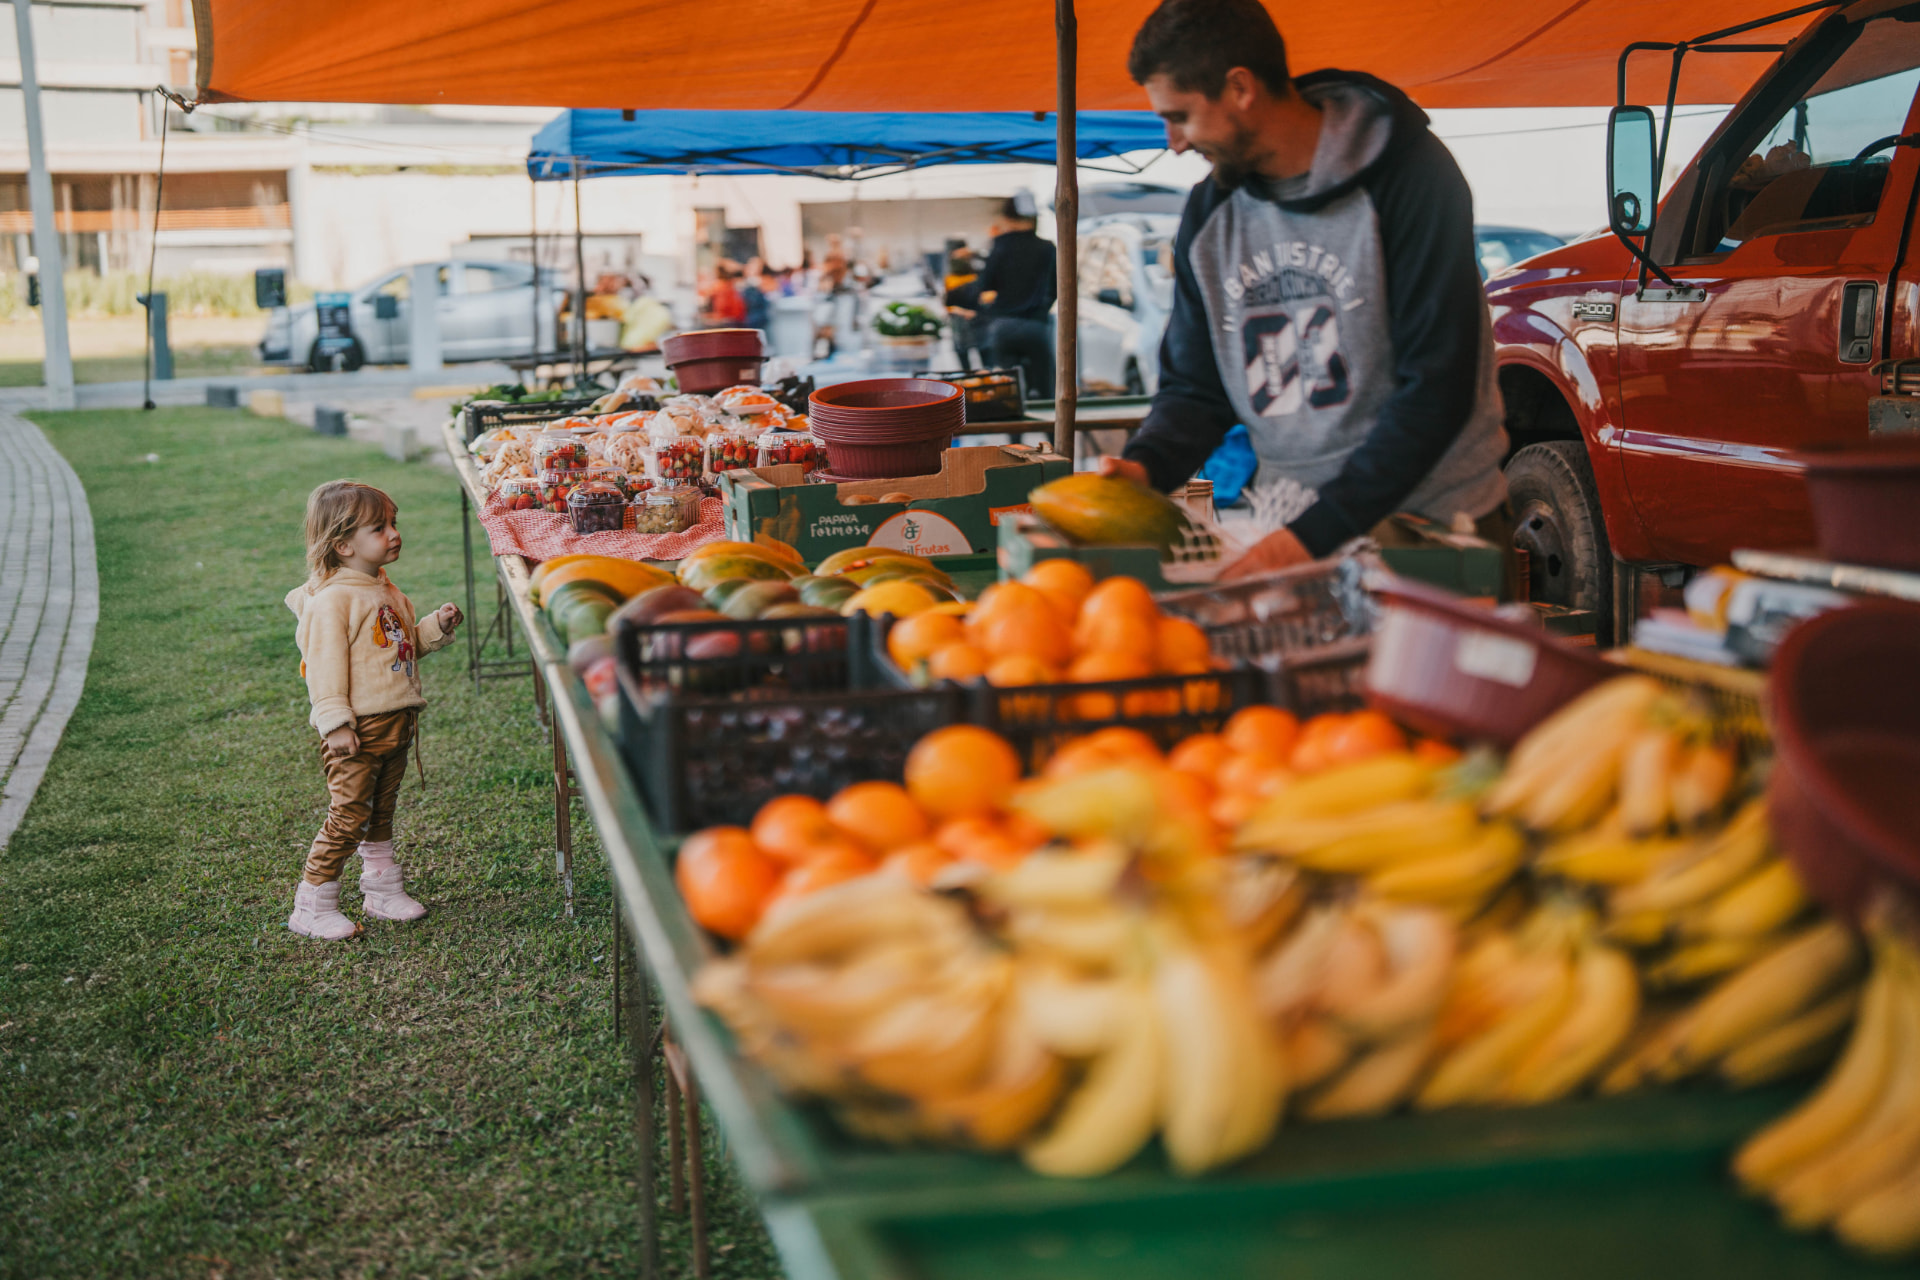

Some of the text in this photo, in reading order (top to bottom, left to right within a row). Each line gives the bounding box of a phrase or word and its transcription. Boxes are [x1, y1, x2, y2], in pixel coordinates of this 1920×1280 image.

[1571, 303, 1614, 316] F4000
[818, 513, 859, 525] PAPAYA
[810, 523, 870, 538] Formosa
